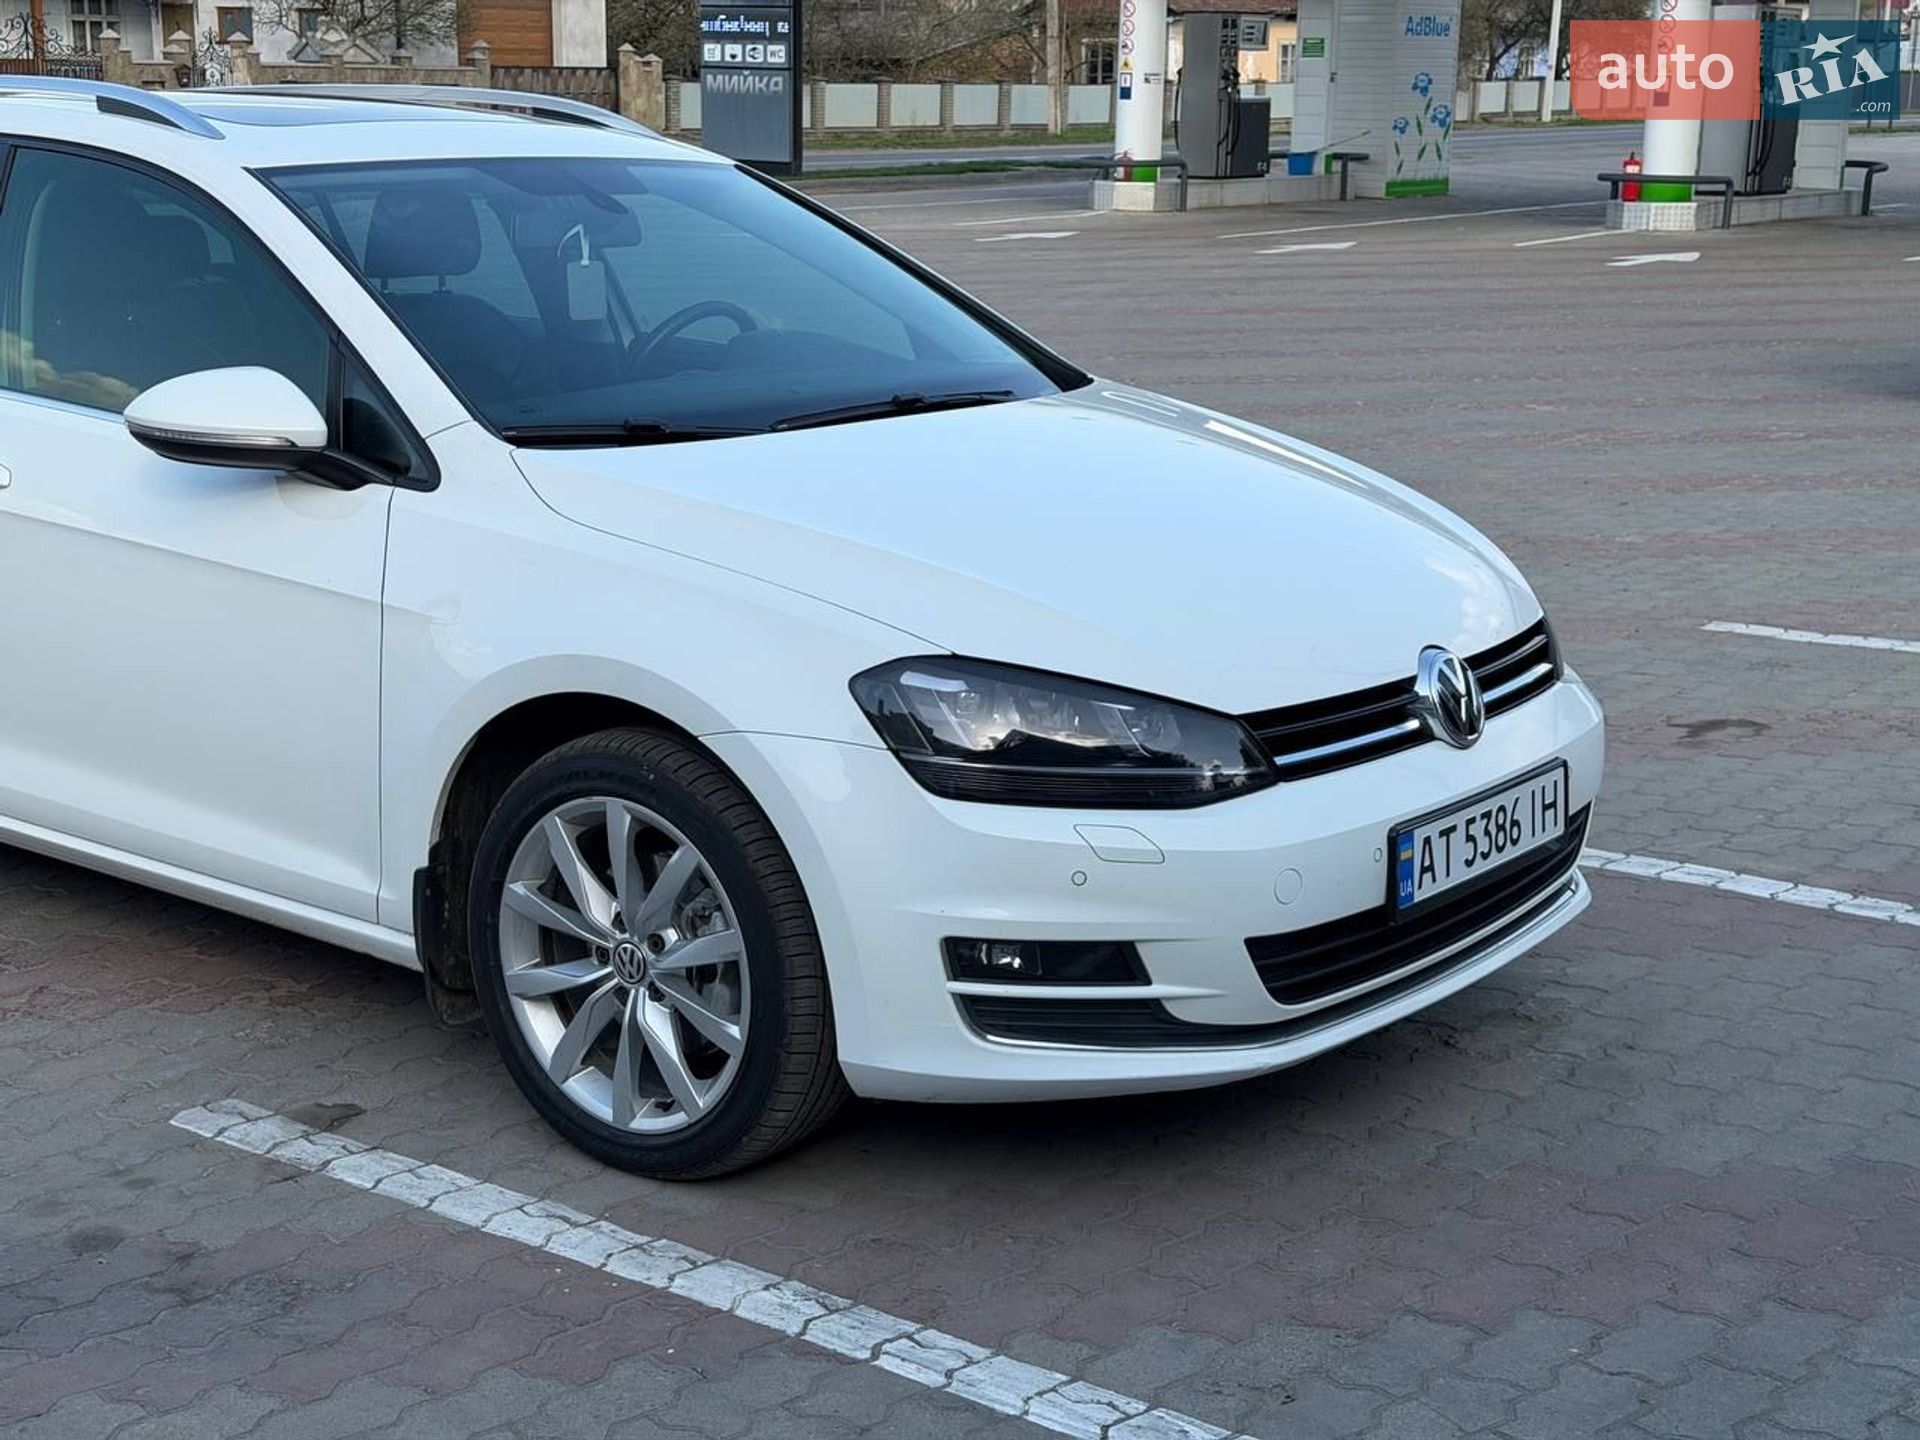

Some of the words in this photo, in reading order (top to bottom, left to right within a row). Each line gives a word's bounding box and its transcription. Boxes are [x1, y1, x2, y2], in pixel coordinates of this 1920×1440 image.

[706, 70, 784, 95] МИЙКА
[1417, 824, 1458, 890] AT
[1464, 796, 1522, 868] 5386
[1531, 780, 1558, 838] IH
[1400, 883, 1413, 897] UA
